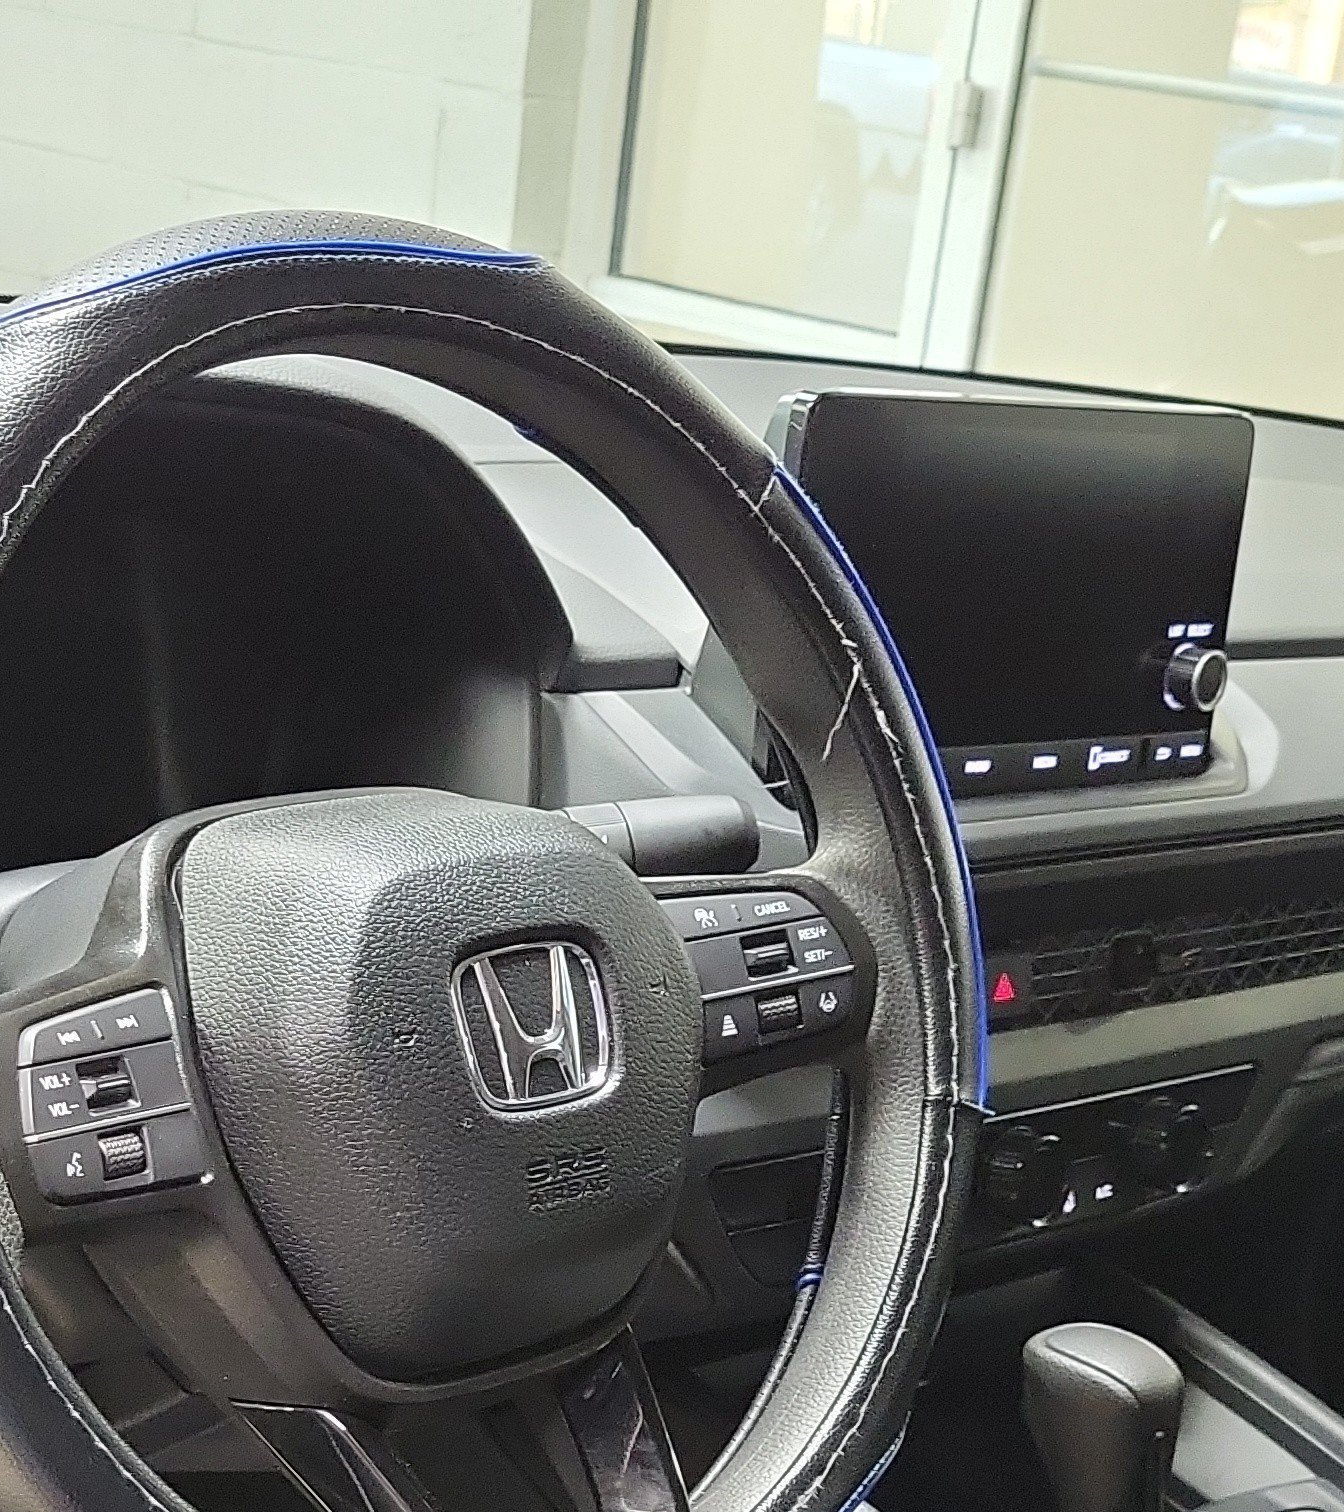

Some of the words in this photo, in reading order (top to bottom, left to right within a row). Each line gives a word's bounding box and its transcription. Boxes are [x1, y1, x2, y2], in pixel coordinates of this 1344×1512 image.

[754, 901, 791, 916] CANCEL
[797, 926, 828, 941] RES/+
[39, 1073, 72, 1091] VOL+
